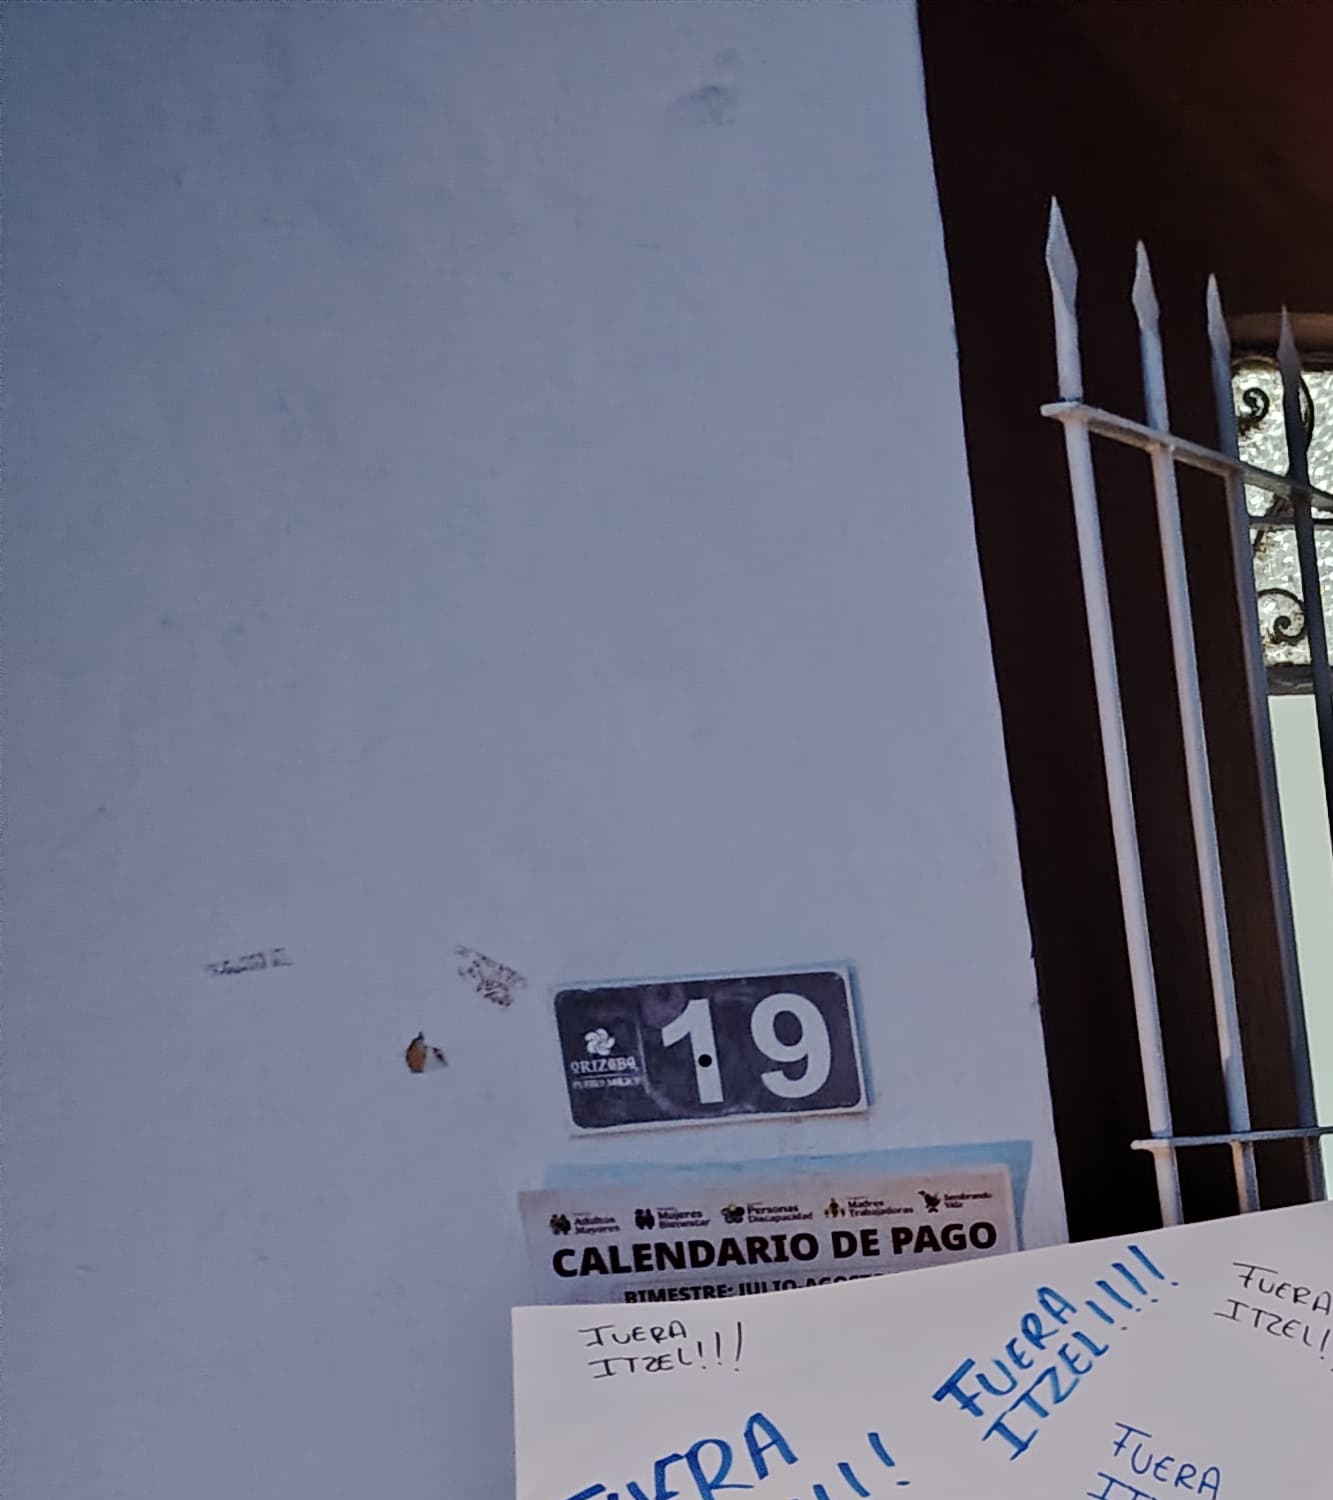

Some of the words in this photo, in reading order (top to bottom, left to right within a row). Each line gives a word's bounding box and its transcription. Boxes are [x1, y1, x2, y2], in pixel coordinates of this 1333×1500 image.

[661, 991, 832, 1105] 19
[552, 1231, 819, 1279] CALENDARIO
[831, 1228, 881, 1260] DE
[890, 1221, 998, 1256] PAGO
[1231, 1260, 1333, 1317] FUERA
[577, 1318, 689, 1349] FUERA
[588, 1320, 746, 1380] ITZEL!!!
[931, 1285, 1078, 1419] FUERA
